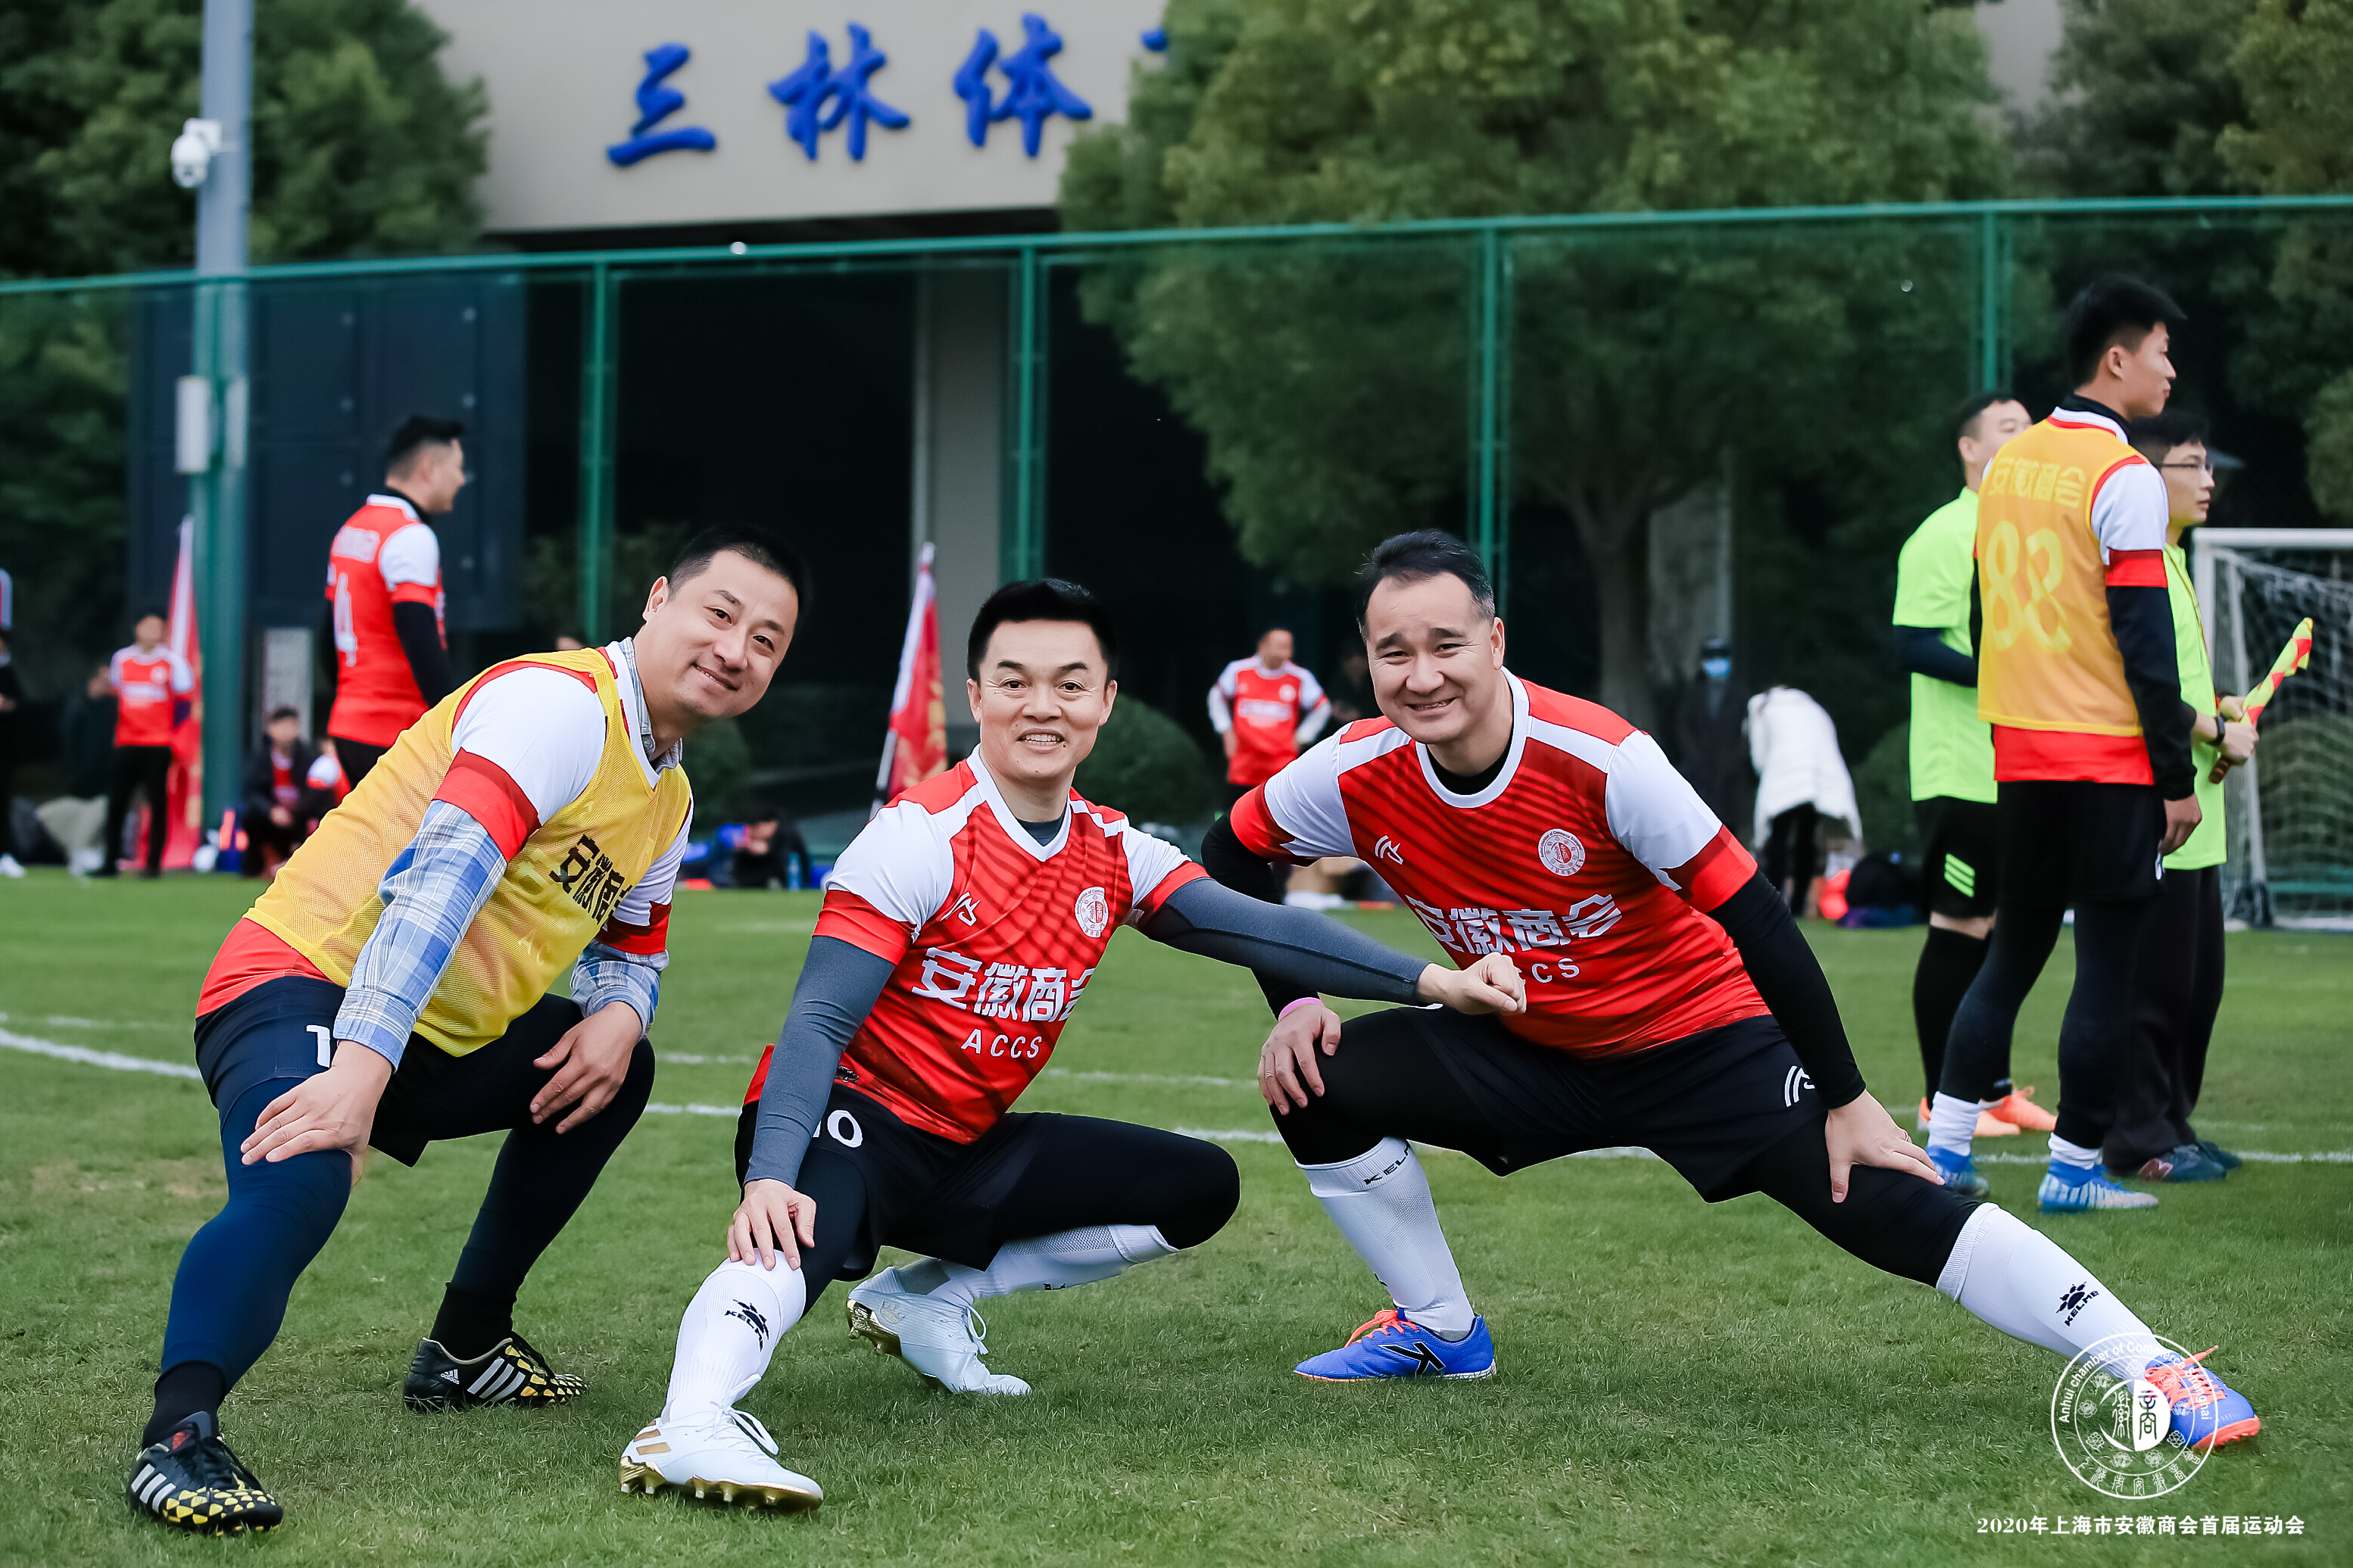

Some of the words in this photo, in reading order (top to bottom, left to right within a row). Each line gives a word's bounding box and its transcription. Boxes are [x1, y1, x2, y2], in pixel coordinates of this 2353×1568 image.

[606, 13, 1167, 167] 三林体
[1985, 520, 2071, 653] 88
[1517, 958, 1580, 984] CS
[961, 1029, 1042, 1058] ACCS
